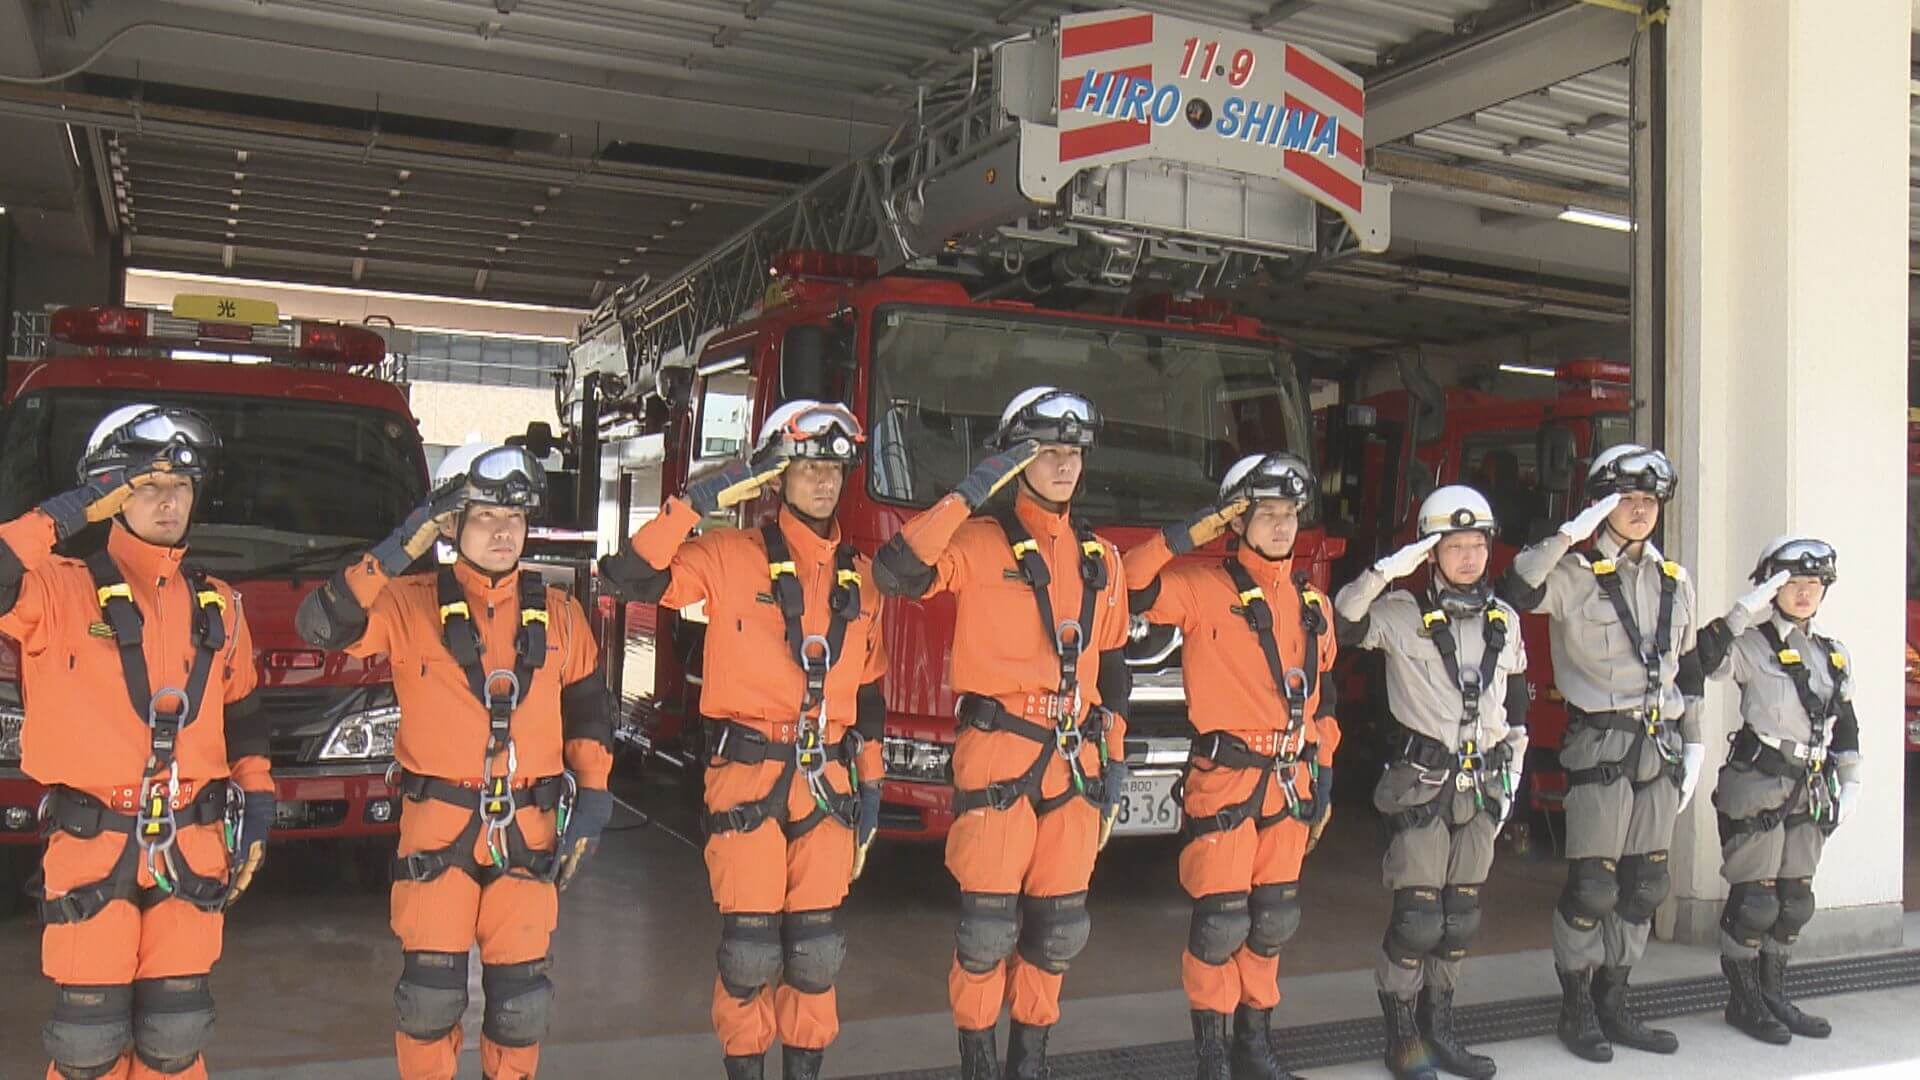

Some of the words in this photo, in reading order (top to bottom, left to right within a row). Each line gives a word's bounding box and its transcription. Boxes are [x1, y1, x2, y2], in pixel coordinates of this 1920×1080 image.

[1074, 68, 1182, 126] HIRO
[1215, 96, 1339, 158] SHIMA
[217, 300, 236, 318] 光
[1118, 794, 1170, 824] 8-36
